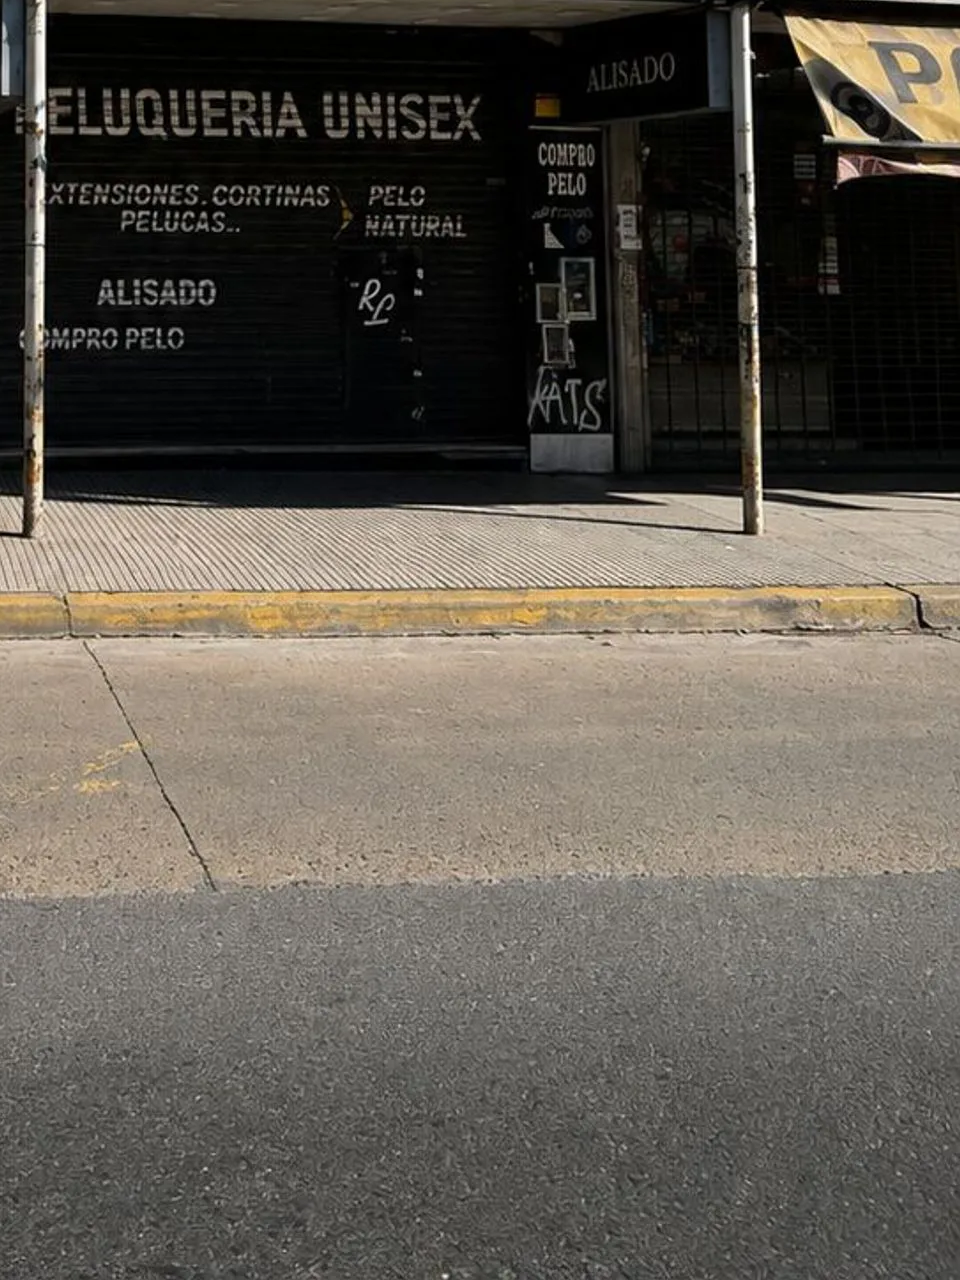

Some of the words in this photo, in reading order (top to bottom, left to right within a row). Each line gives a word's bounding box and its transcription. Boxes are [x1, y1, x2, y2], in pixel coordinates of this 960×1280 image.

[586, 51, 676, 94] ALISADO
[15, 86, 308, 140] ELUQUERIA
[322, 90, 482, 141] UNISEX
[537, 142, 596, 167] COMPRO
[41, 182, 208, 207] XTENSIONES.
[211, 184, 331, 207] CORTINAS
[368, 185, 426, 207] PELO
[547, 172, 587, 196] PELO
[364, 214, 468, 238] NATURAL
[96, 278, 218, 307] ALISADO
[124, 327, 185, 350] PELO
